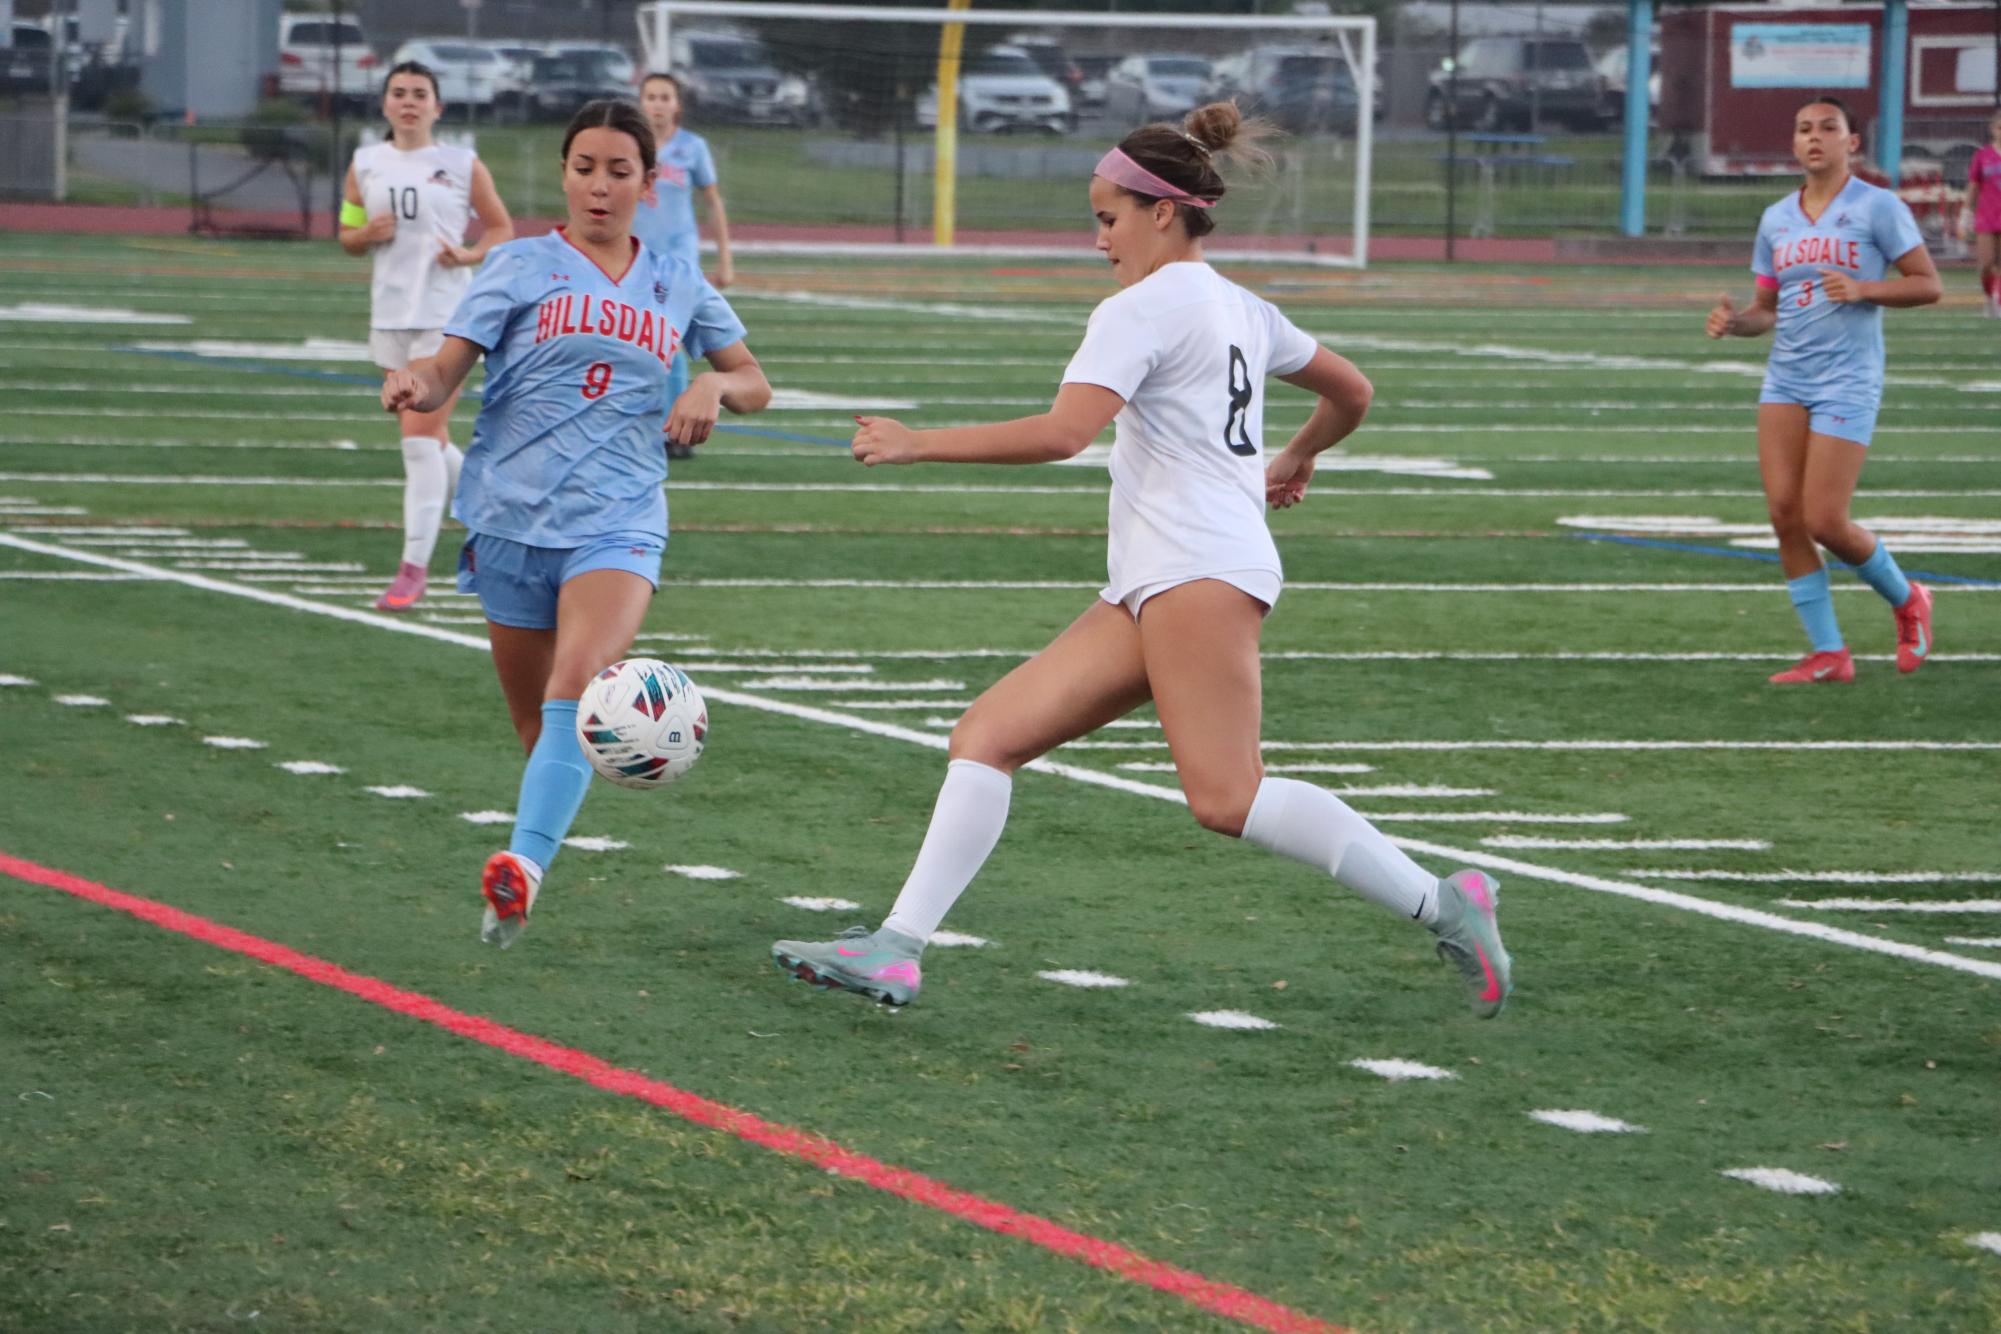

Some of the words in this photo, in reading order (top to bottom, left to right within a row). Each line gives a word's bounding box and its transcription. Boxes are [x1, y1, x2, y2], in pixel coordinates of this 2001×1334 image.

[389, 187, 417, 220] 10
[1797, 280, 1814, 307] 3
[581, 362, 613, 400] 9
[1224, 344, 1257, 457] 8
